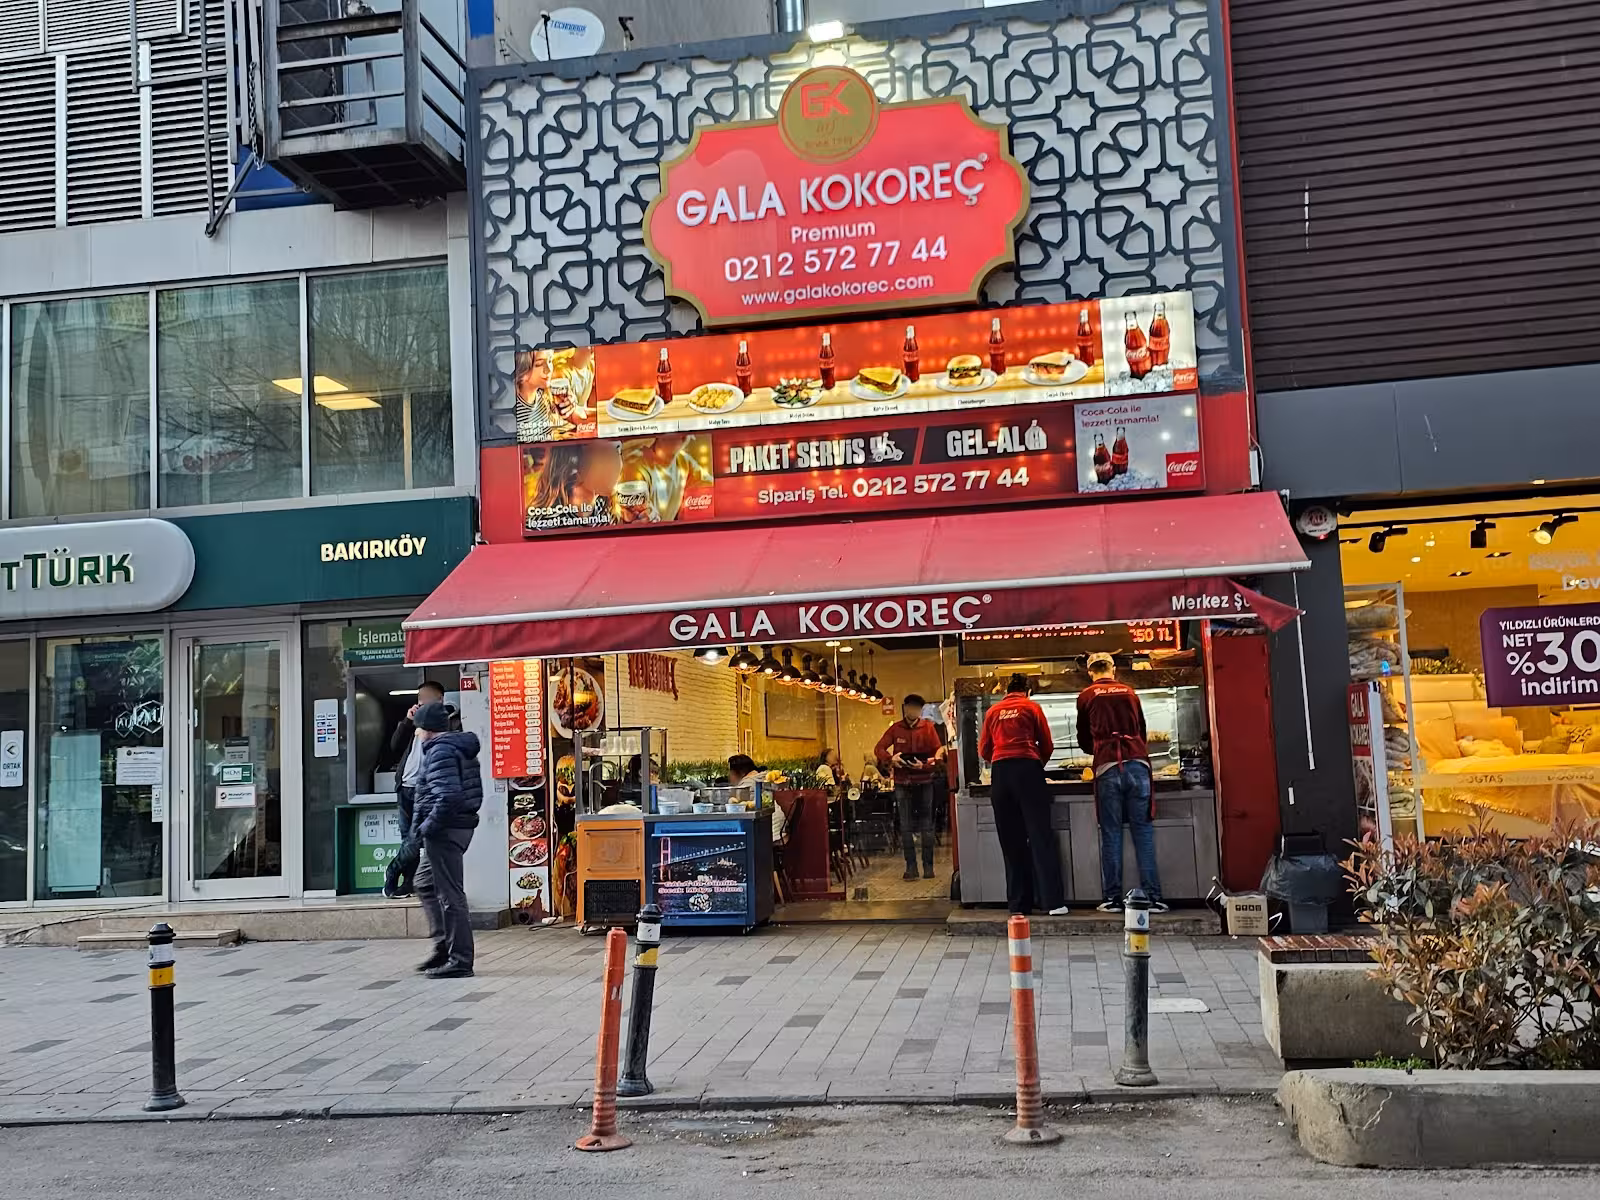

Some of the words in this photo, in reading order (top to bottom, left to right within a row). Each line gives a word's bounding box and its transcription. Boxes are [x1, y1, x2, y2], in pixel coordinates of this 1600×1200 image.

[676, 180, 786, 227] GALA
[724, 251, 794, 283] 0212
[803, 245, 857, 275] 572
[867, 241, 901, 269] 77
[910, 235, 949, 262] 44
[741, 273, 934, 306] www.galakokorec.com
[1081, 405, 1129, 417] Coca-Cola
[1081, 417, 1113, 428] lezzeti
[1113, 414, 1161, 425] tamamla!
[729, 443, 792, 474] PAKET
[946, 425, 1026, 457] GEL-AL
[758, 487, 815, 506] Sipariş
[819, 484, 848, 500] Tel.
[852, 477, 907, 498] 0212
[913, 472, 957, 494] 572
[961, 469, 991, 490] 77
[997, 466, 1030, 488] 44
[527, 503, 579, 517] Coca-Cola
[320, 533, 427, 563] BAKIRKÖY
[1171, 593, 1230, 611] Merkez
[669, 609, 776, 641] GALA
[1499, 618, 1542, 631] YILDIZLI
[1157, 627, 1174, 642] TL
[1502, 632, 1534, 648] NET
[1520, 675, 1599, 696] indirim
[2, 762, 22, 770] ORTAK
